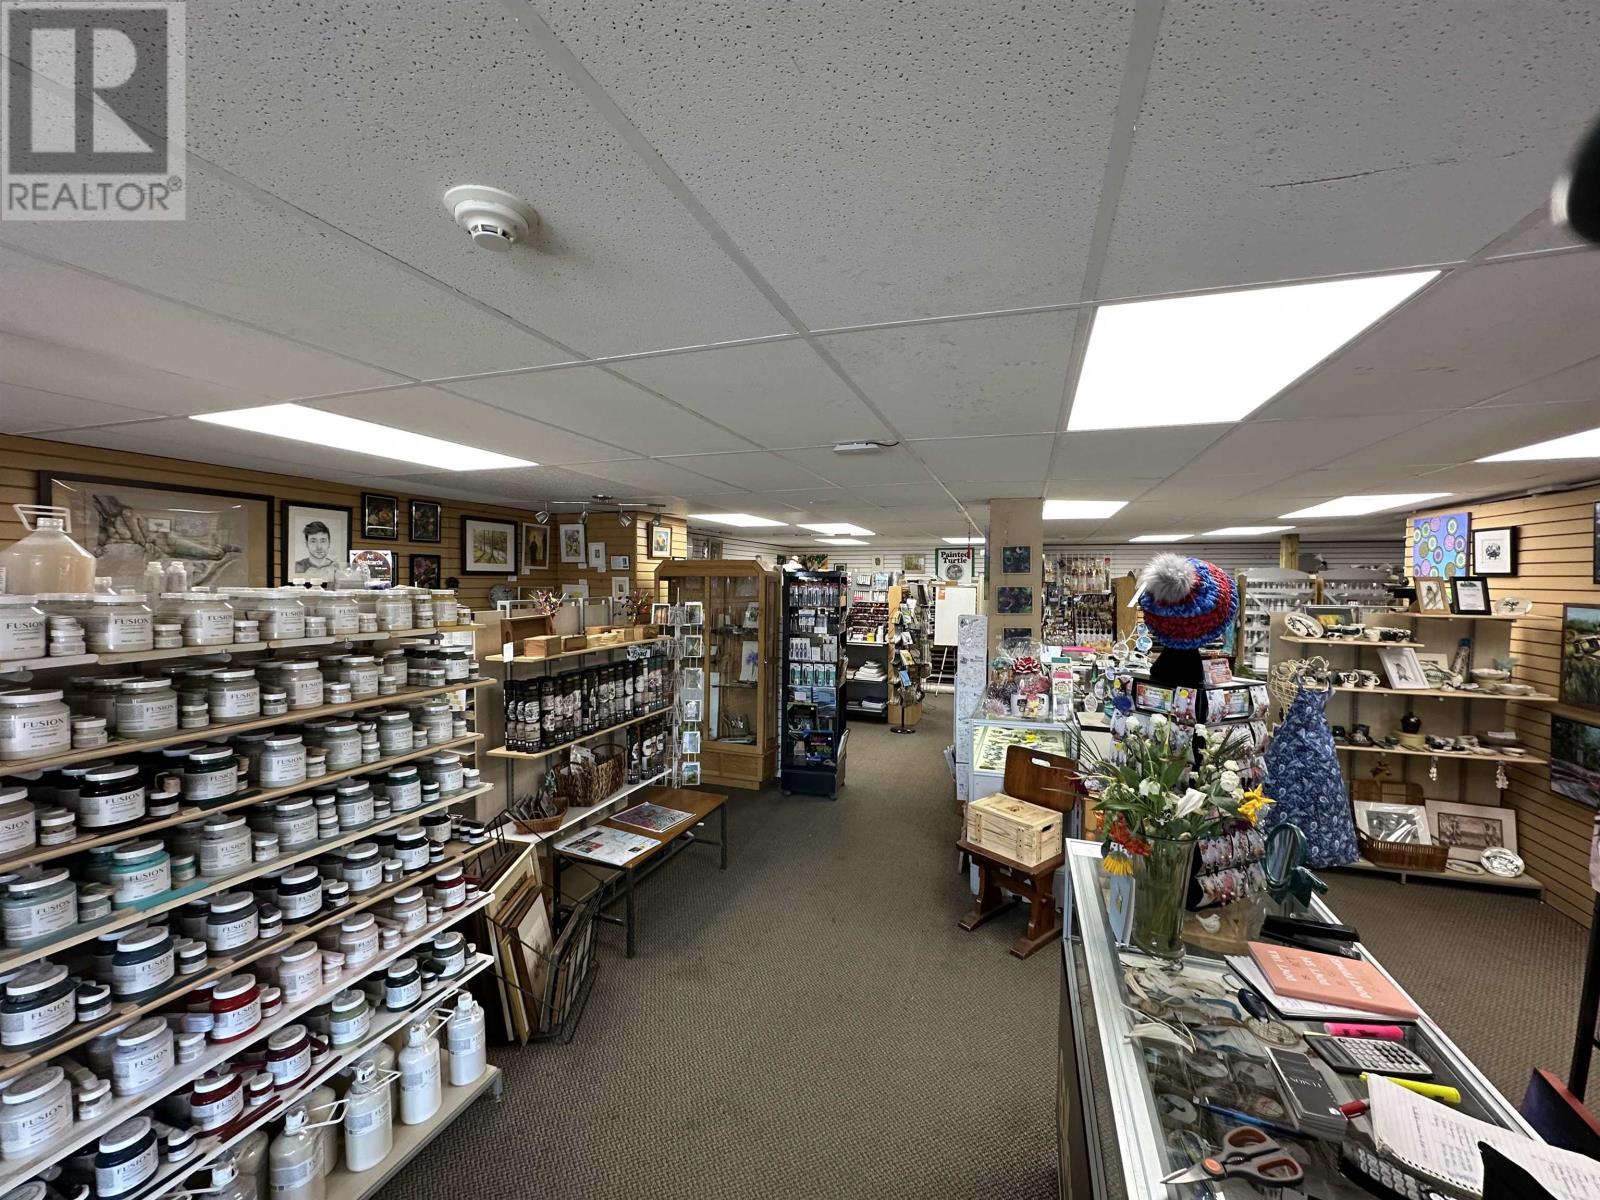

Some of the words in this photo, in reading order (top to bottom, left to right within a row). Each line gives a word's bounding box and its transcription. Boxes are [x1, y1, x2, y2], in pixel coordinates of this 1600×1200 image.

[23, 718, 64, 729] FUSION
[106, 793, 140, 804] FUSION
[0, 820, 29, 831] SION
[222, 843, 246, 852] FUSION
[130, 868, 164, 881] FUSION
[37, 900, 70, 914] FUSION
[223, 921, 251, 932] FUSION
[142, 955, 172, 971] FUSION
[32, 1000, 70, 1019] FUSION
[135, 1049, 168, 1068] FUSION
[22, 1105, 63, 1128] FUSION
[117, 1153, 151, 1174] FUSION
